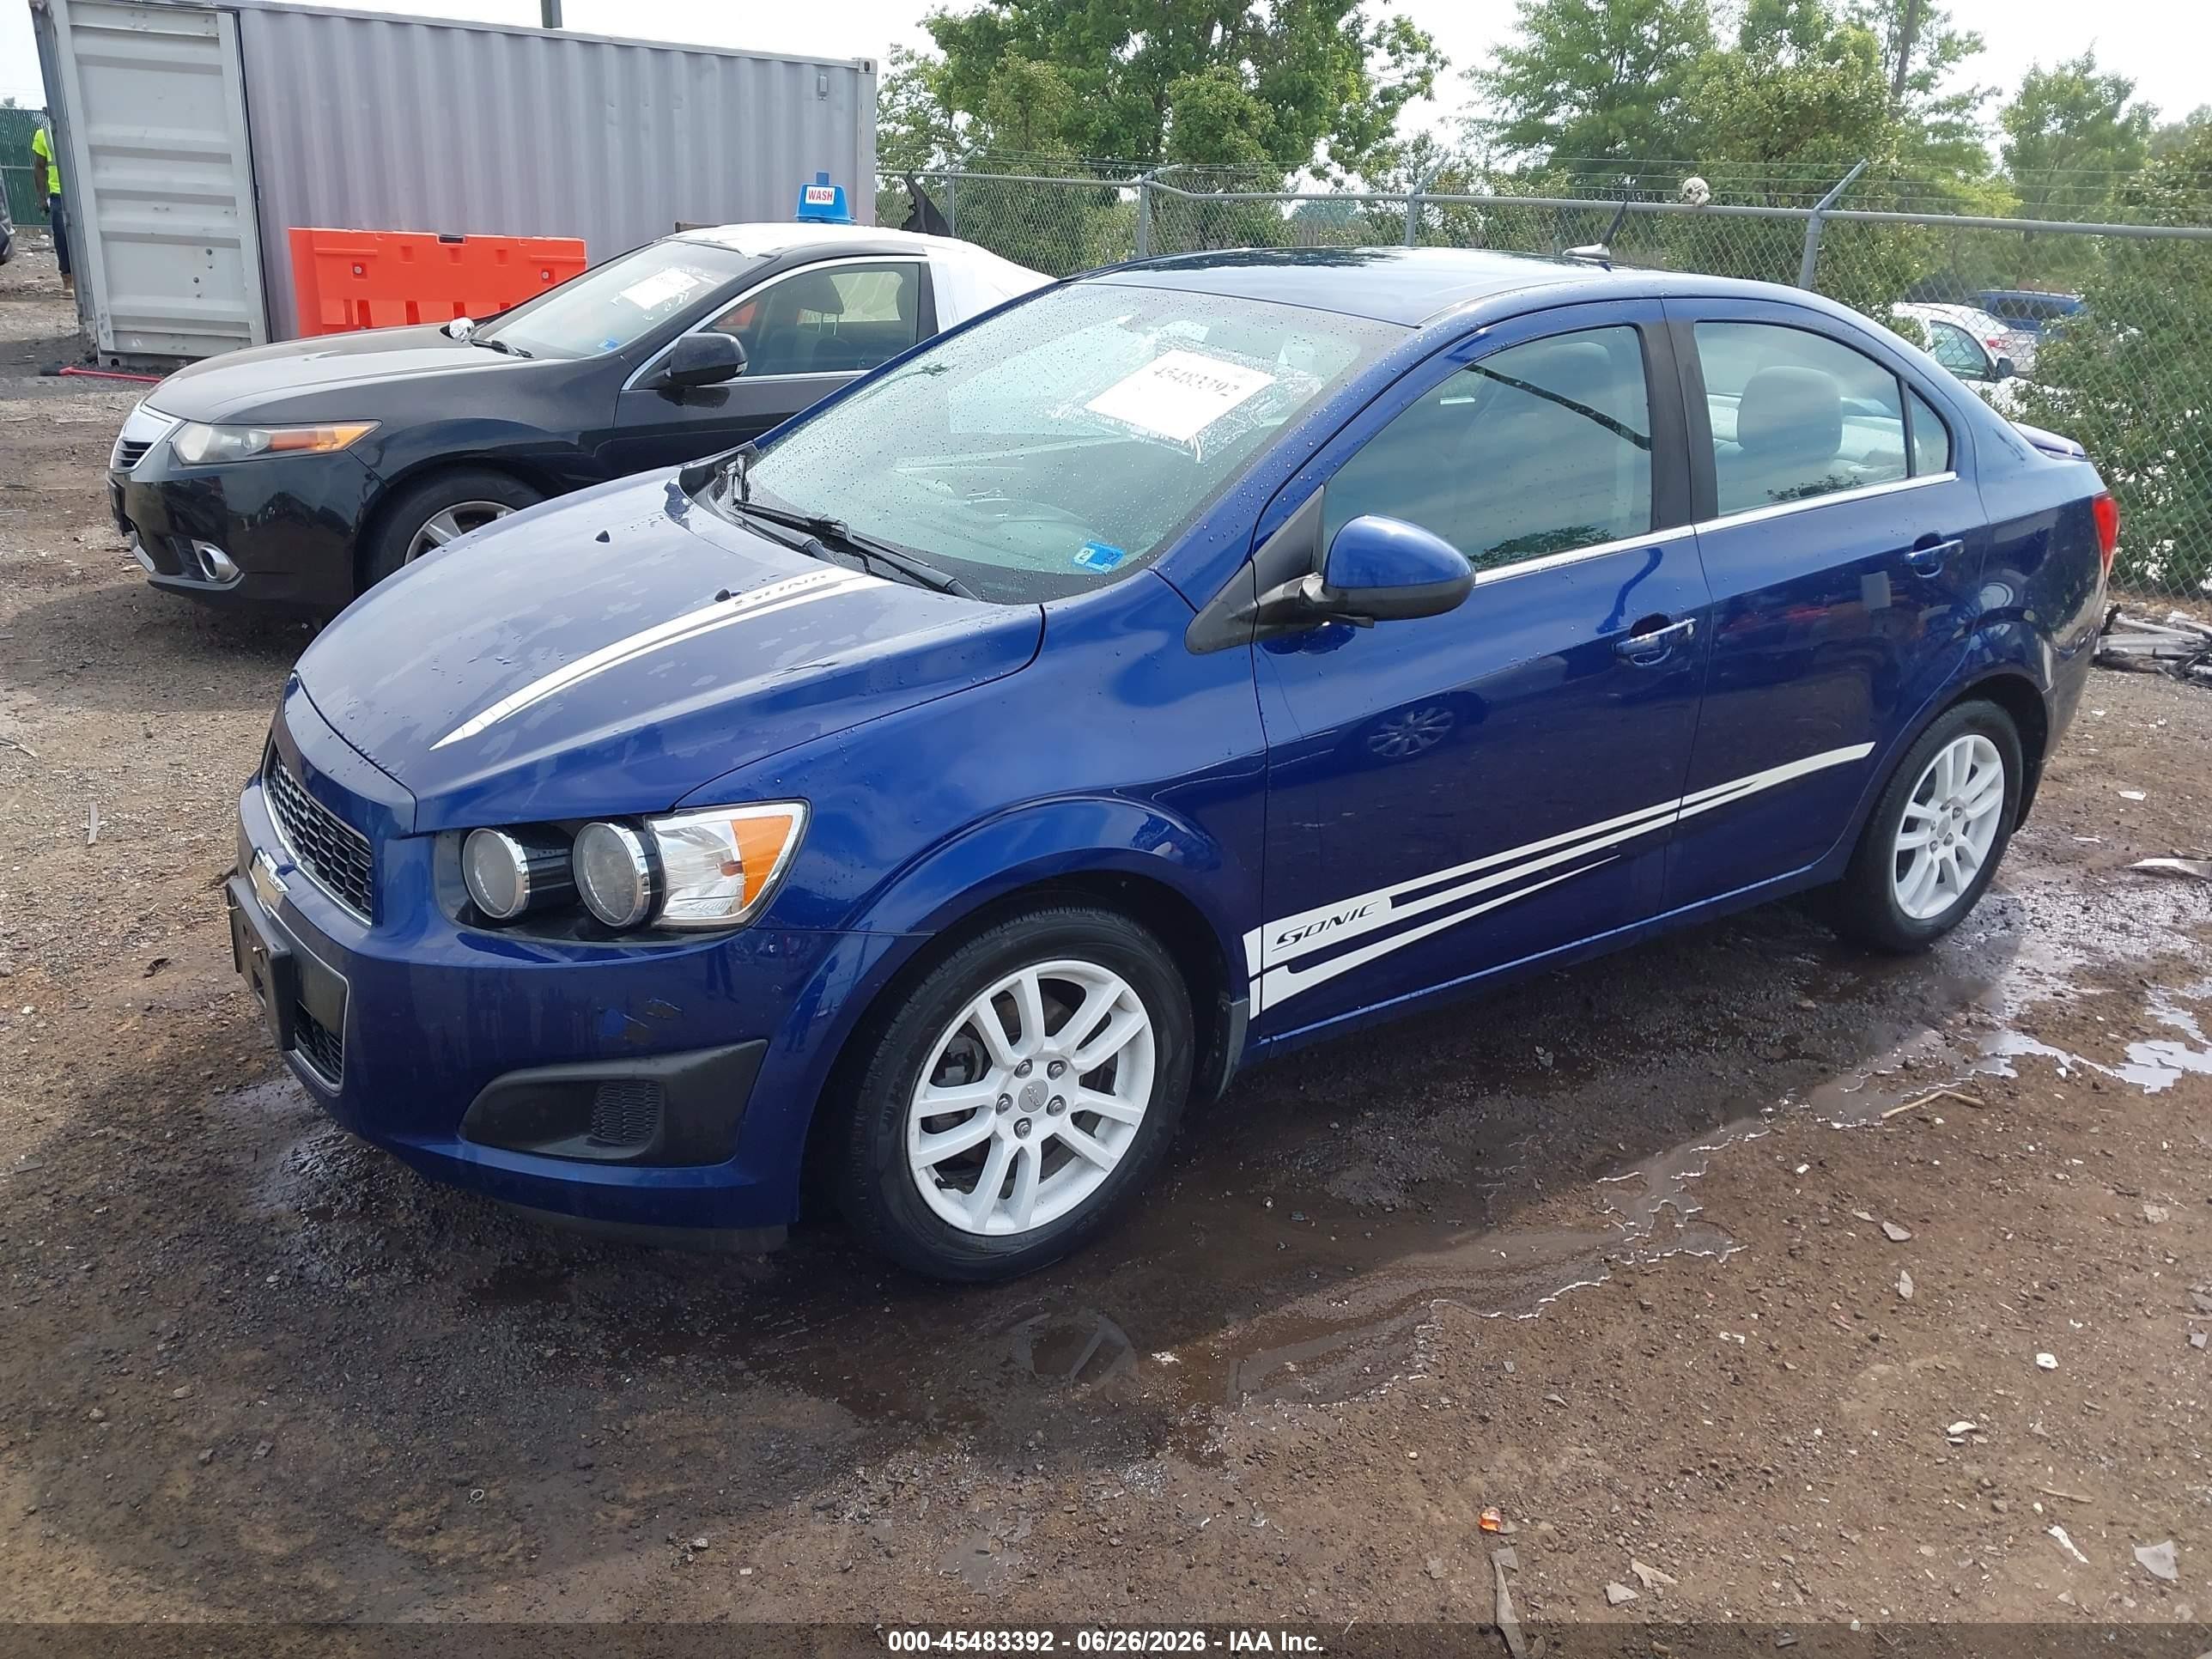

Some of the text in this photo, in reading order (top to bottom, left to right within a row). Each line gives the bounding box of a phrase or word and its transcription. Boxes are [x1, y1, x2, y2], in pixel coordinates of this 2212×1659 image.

[808, 190, 834, 201] WASH
[1079, 550, 1091, 561] 2
[1271, 901, 1379, 952] SONIC
